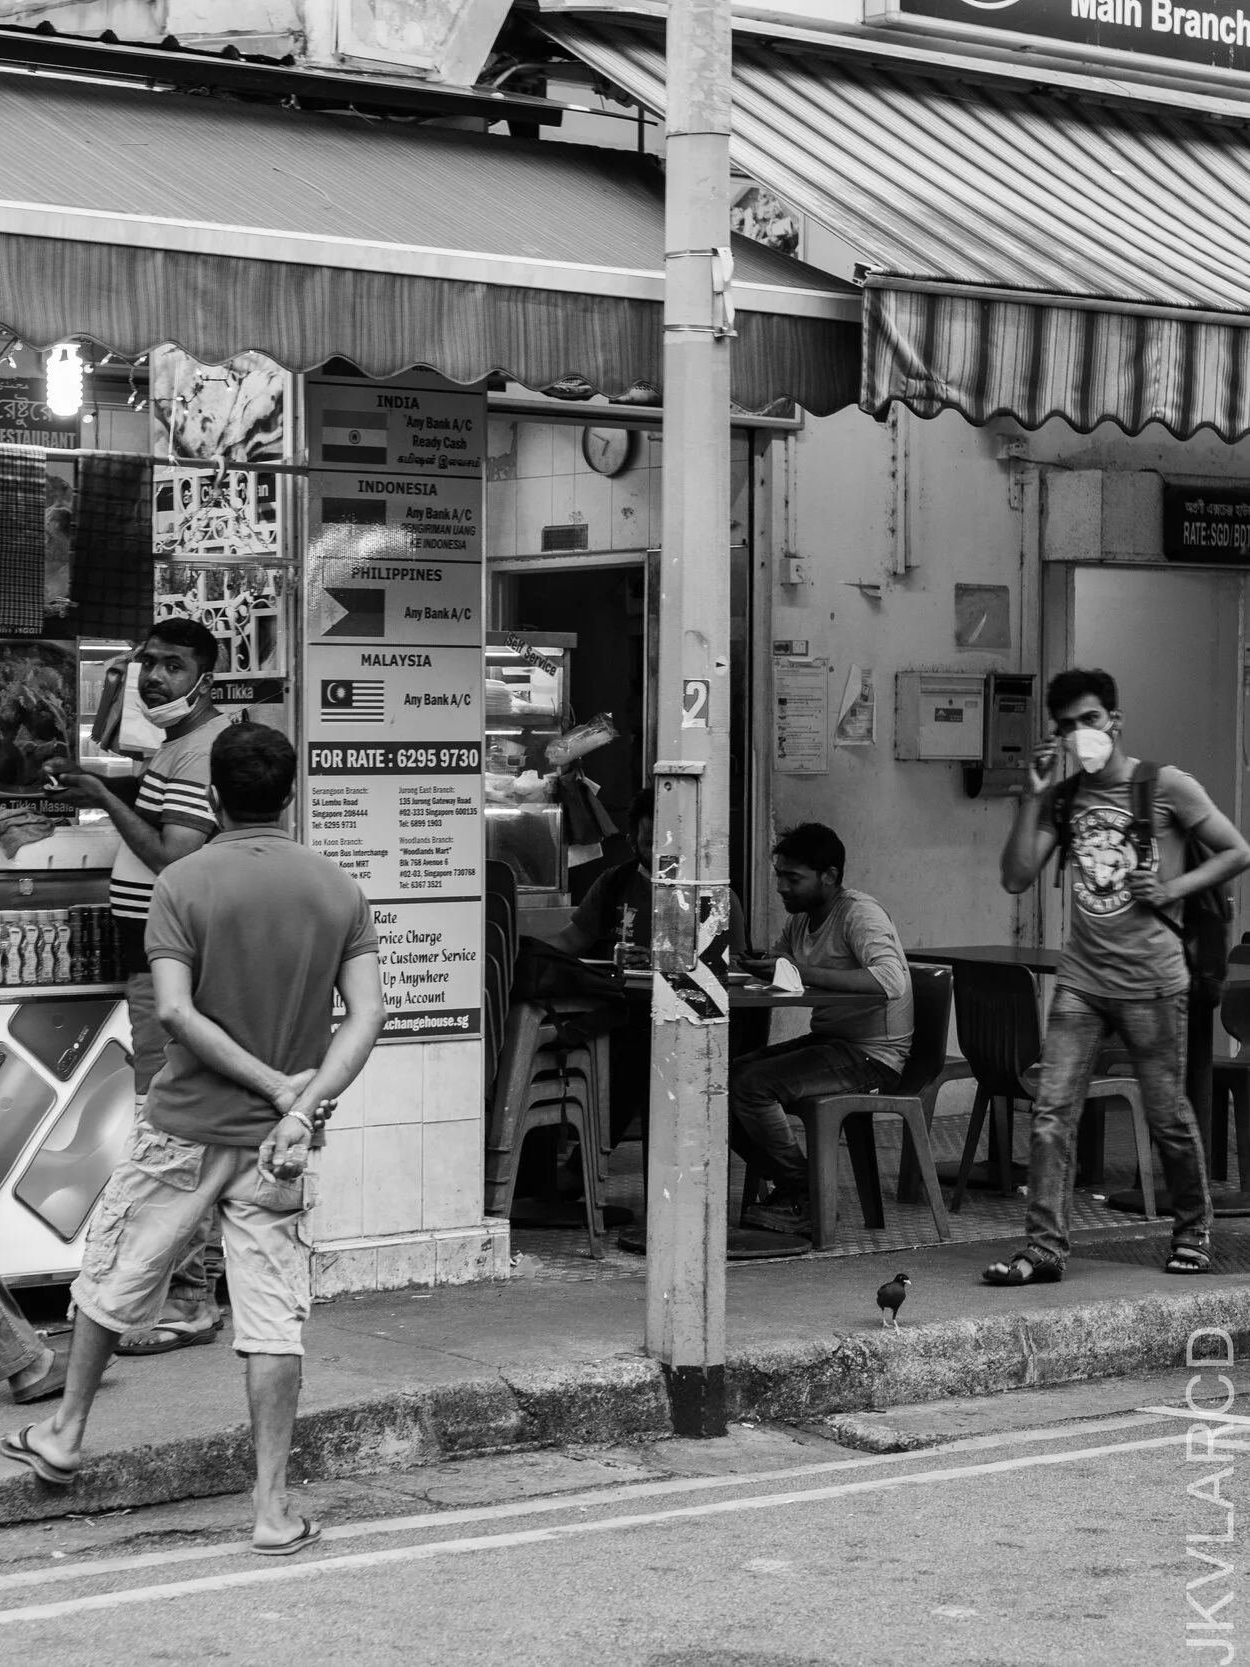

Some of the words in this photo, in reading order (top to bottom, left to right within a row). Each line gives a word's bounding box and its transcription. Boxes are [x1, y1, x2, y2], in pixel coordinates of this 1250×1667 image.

[1071, 0, 1142, 27] Main
[1152, 0, 1250, 47] Branch
[377, 394, 419, 410] INDIA
[406, 415, 424, 431] Any
[426, 417, 450, 430] Bank
[453, 418, 473, 433] A/C
[412, 435, 441, 451] Ready
[443, 437, 467, 450] Cash
[358, 479, 438, 496] INDONESIA
[406, 506, 424, 521] Any
[426, 507, 450, 520] Bank
[452, 508, 472, 523] A/C
[453, 525, 476, 536] UANG
[423, 538, 467, 550] INDONESIA
[352, 567, 442, 582] PHILIPPINES
[404, 606, 423, 623] Any
[425, 608, 449, 621] Bank
[451, 609, 471, 623] A/C
[361, 654, 432, 667] MALAYSIA
[506, 633, 525, 654] Self
[524, 645, 557, 677] Service
[225, 682, 254, 699] Tikka
[404, 693, 422, 709] Any
[424, 694, 449, 706] Bank
[451, 694, 471, 708] A/C
[682, 681, 707, 728] 2
[311, 750, 343, 768] FOR
[347, 750, 385, 768] RATE
[397, 749, 437, 767] 6295
[440, 749, 479, 767] 9730
[399, 786, 418, 795] Jurong
[419, 786, 432, 794] East
[399, 797, 411, 805] 135
[411, 797, 431, 806] Jurong
[431, 797, 456, 806] Gateway
[312, 810, 342, 819] Singapore
[425, 808, 454, 817] Singapore
[455, 808, 478, 816] 600135
[324, 821, 340, 829] 6295
[341, 821, 357, 829] 9731
[352, 849, 389, 857] Interchange
[355, 860, 369, 868] MRT
[424, 869, 453, 879] Singapore
[374, 910, 398, 924] Rate
[377, 931, 403, 945] rvice
[406, 930, 442, 946] Charge
[390, 952, 439, 964] Customer
[441, 948, 476, 962] Service
[383, 972, 397, 988] Up
[399, 970, 449, 987] Anywhere
[382, 993, 401, 1008] Any
[404, 991, 446, 1004] Account
[383, 1015, 469, 1031] xchangehouse.sg
